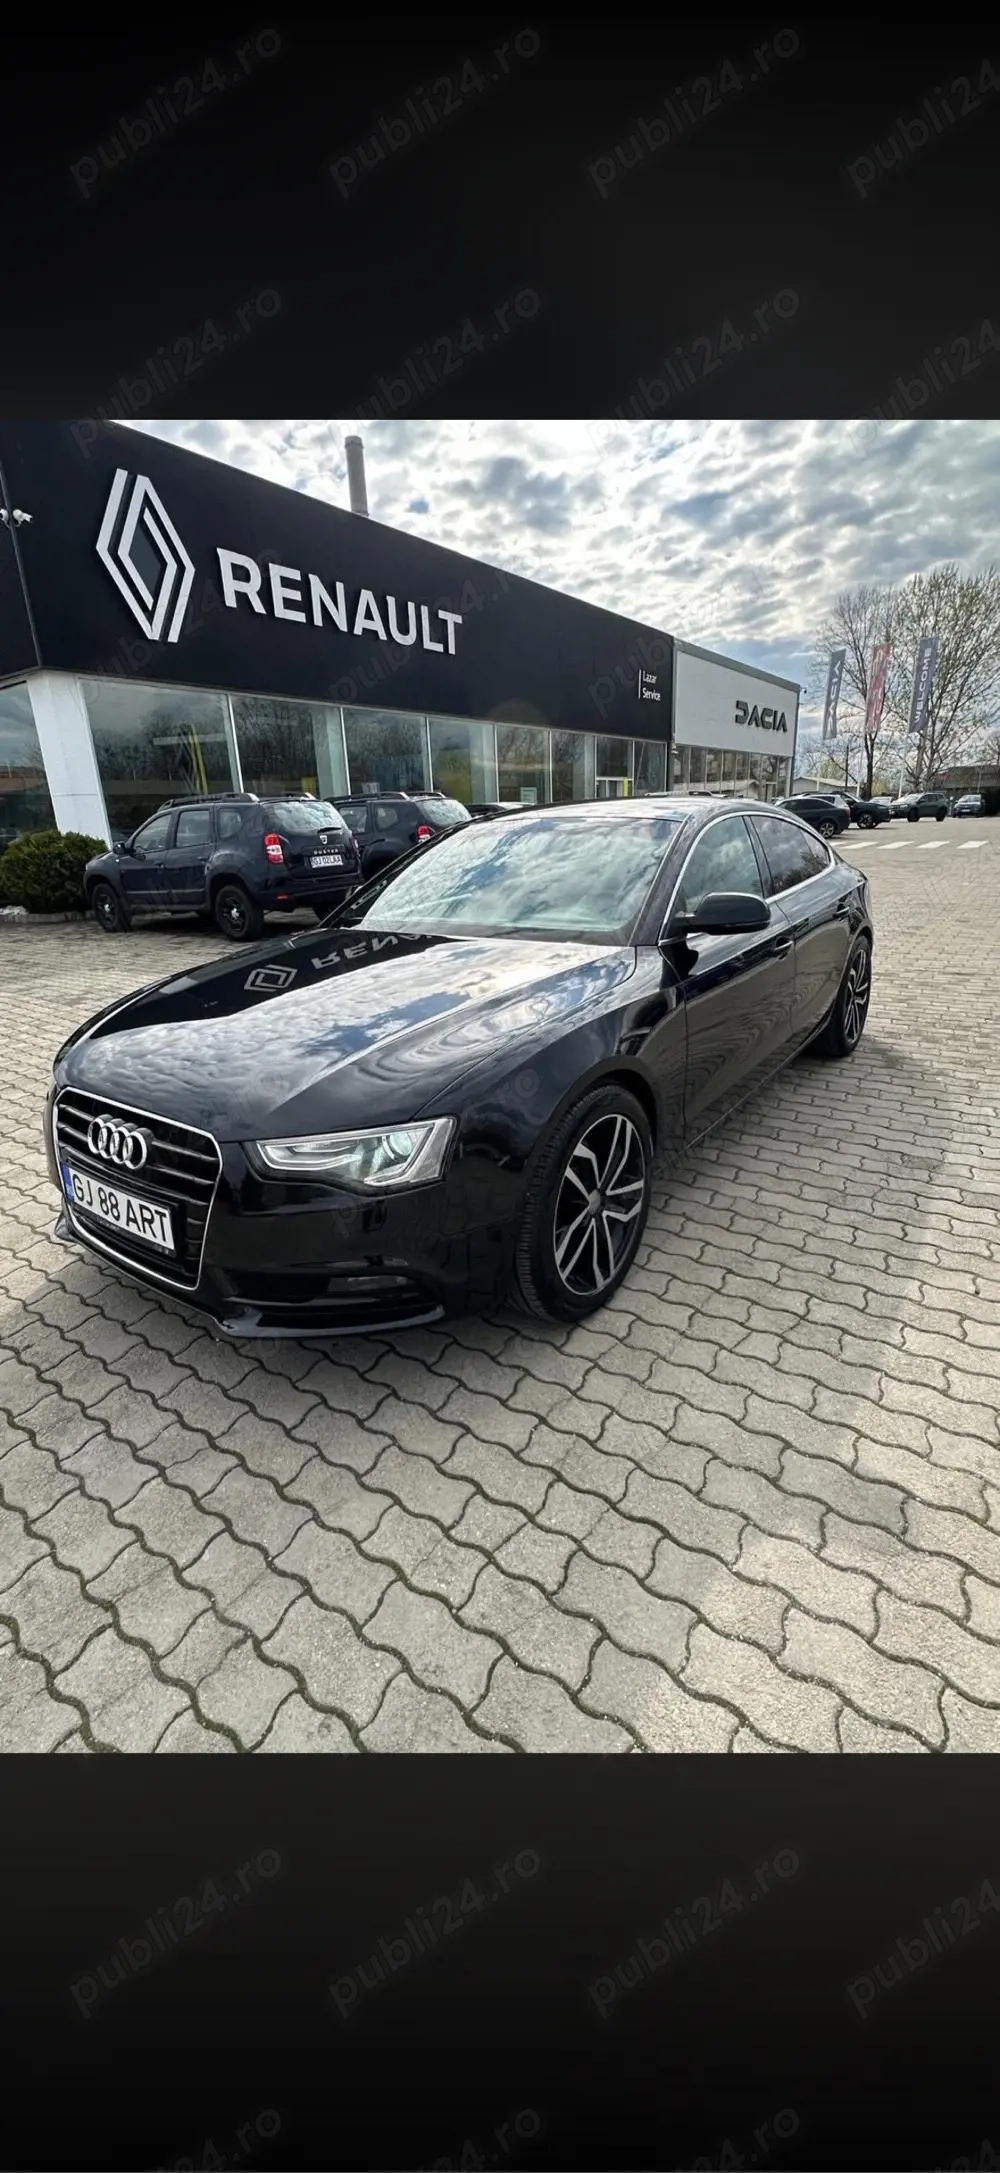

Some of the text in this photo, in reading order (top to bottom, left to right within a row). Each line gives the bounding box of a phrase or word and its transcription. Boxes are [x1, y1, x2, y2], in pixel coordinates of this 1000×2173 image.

[216, 547, 463, 655] RENAULT
[642, 670, 658, 684] Lazar
[642, 687, 661, 701] Service
[914, 647, 932, 724] WELCOME
[735, 700, 788, 733] DACIA
[72, 1173, 94, 1207] GJ
[97, 1186, 121, 1222] 88
[126, 1199, 168, 1243] ART
